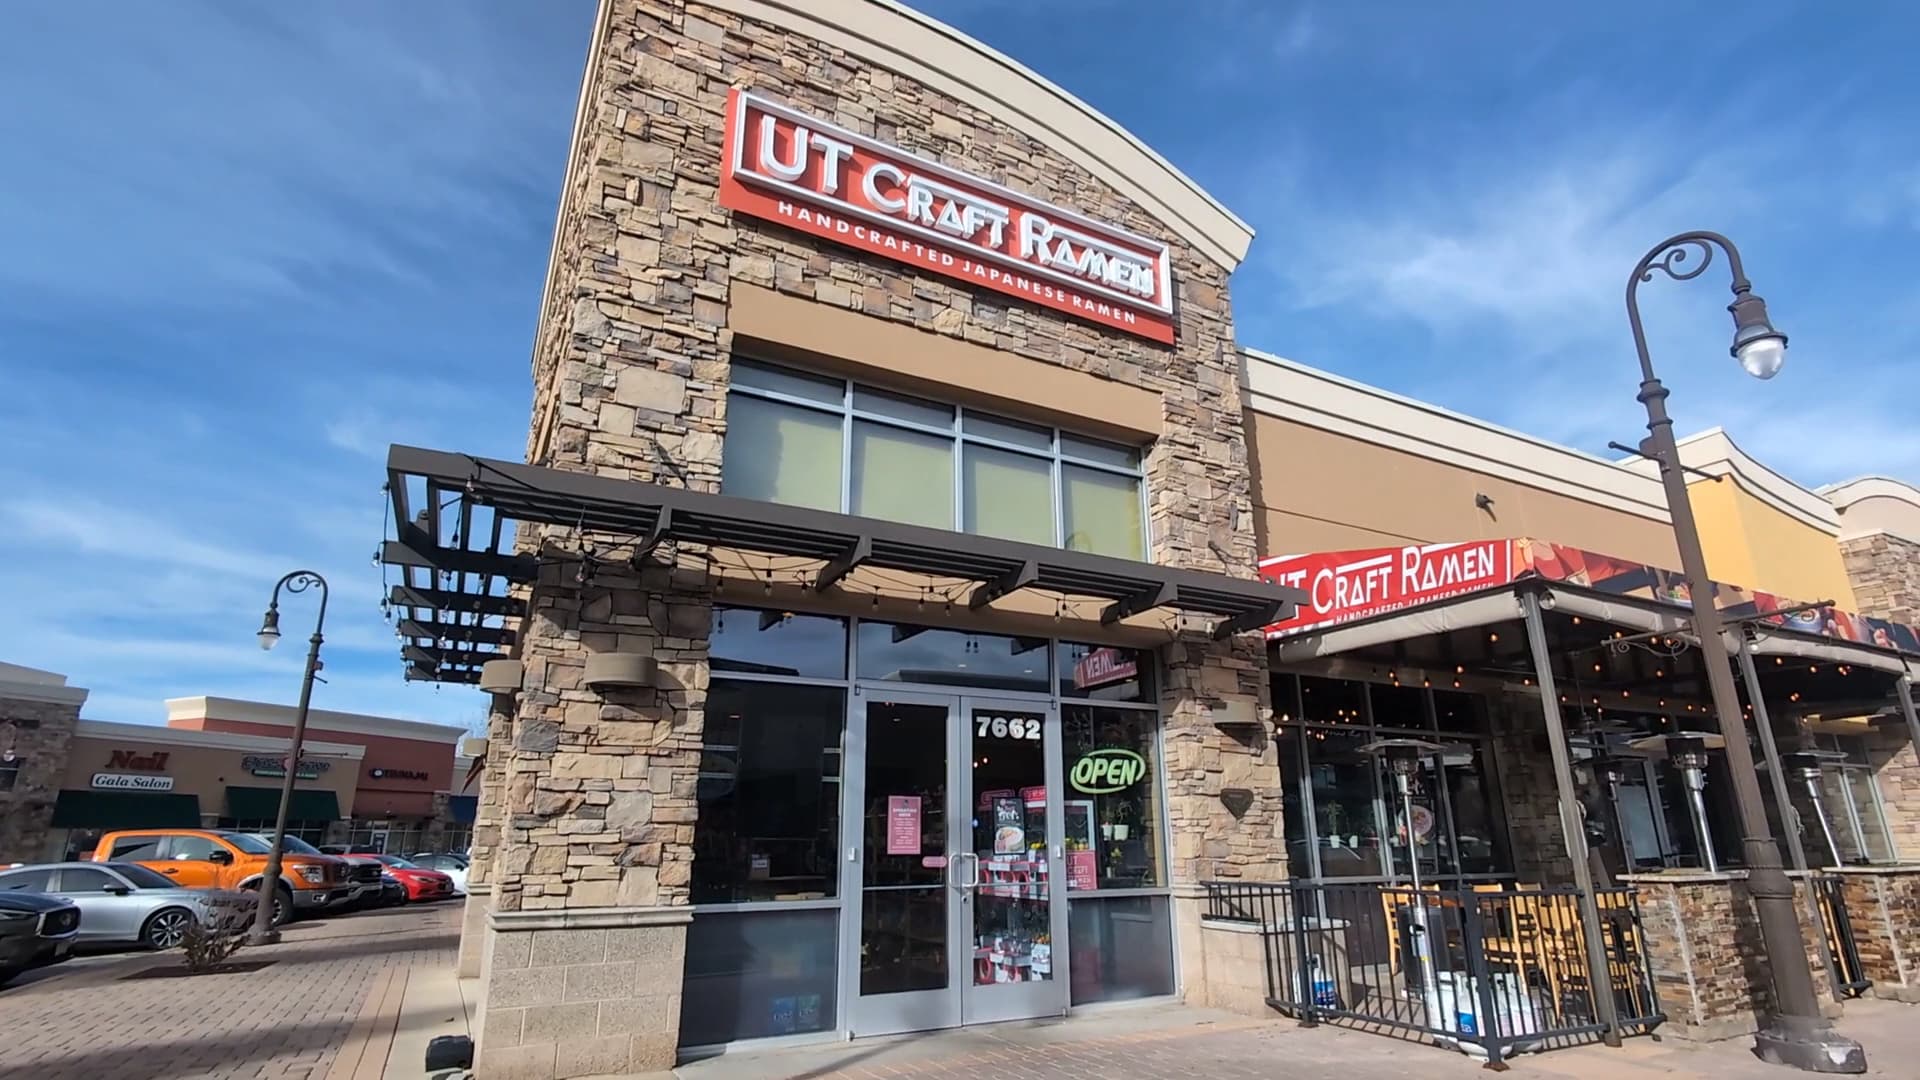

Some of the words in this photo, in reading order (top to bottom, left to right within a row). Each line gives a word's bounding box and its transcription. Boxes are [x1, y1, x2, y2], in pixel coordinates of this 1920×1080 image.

[760, 114, 853, 195] UT
[862, 162, 1009, 249] CRAFT
[1020, 212, 1155, 299] RAMEN
[778, 200, 954, 267] HANDCRAFTED
[962, 259, 1065, 303] JAPANESE
[1072, 296, 1136, 325] RAMEN
[1280, 569, 1307, 620] T
[1312, 556, 1392, 615] CRAFT
[1402, 544, 1494, 596] RAMEN
[976, 716, 1041, 740] 7662
[104, 750, 170, 771] Nail
[1076, 757, 1138, 786] OPEN
[95, 775, 129, 787] Gala
[131, 777, 171, 789] Salon
